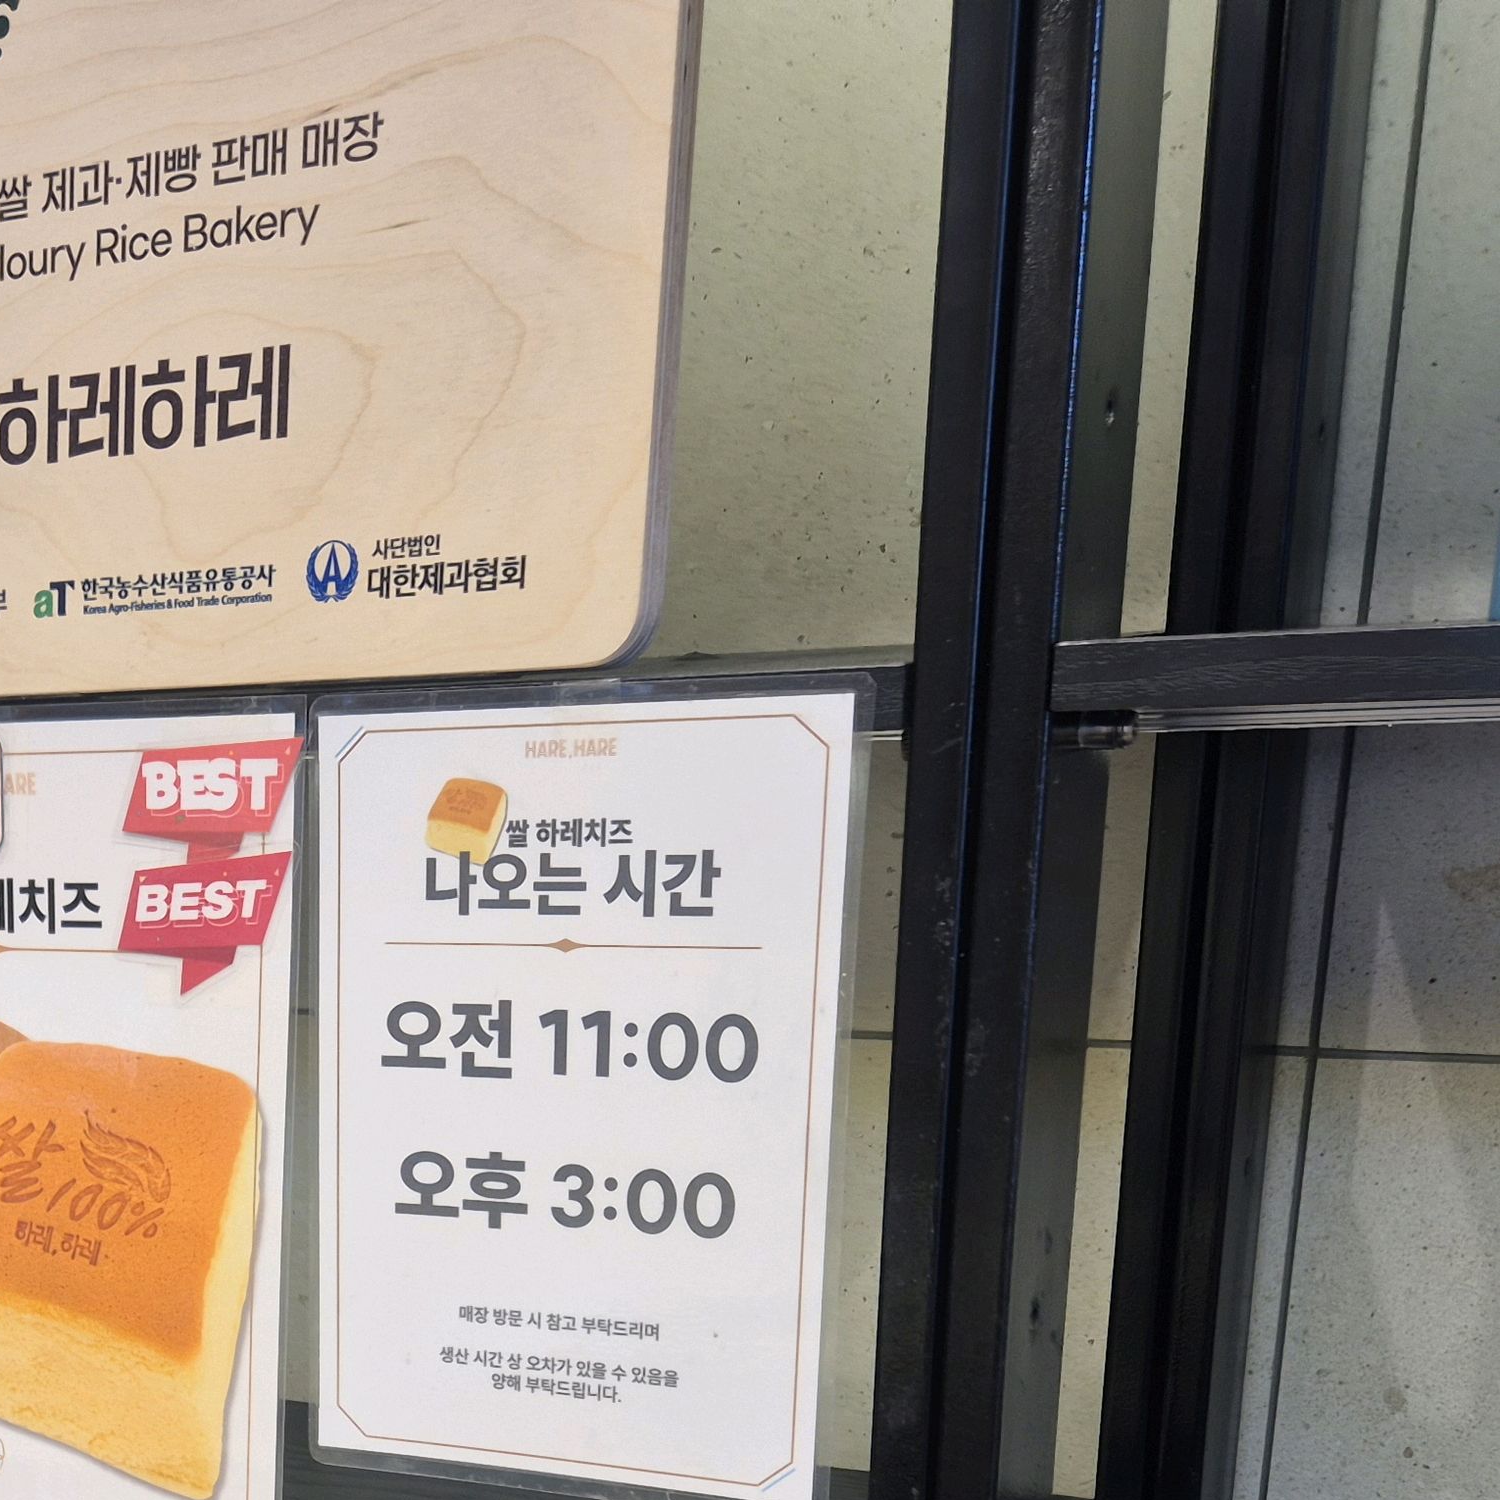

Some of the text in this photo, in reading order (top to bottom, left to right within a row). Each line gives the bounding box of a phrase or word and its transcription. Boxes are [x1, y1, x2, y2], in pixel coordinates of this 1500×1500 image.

[41, 146, 200, 214] 제과·제빵
[211, 127, 288, 186] 판매
[302, 111, 384, 171] 매장
[95, 226, 172, 268] Rice
[184, 201, 320, 254] Bakery
[371, 533, 441, 560] 사단법인
[33, 580, 76, 618] aT
[81, 564, 277, 601] 한국농수산식품유통공사
[367, 555, 526, 600] 대한제과협회
[83, 592, 273, 615] Korea Agro-Fisheries & Food Trade Corporation
[141, 757, 282, 814] BEST
[506, 817, 634, 848] 쌀 하레치즈
[134, 879, 270, 924] BEST
[424, 849, 722, 918] 나오는 시간
[380, 999, 760, 1084] 오전 11:00
[45, 1176, 165, 1240] 100%
[394, 1149, 736, 1239] 오후 3:00
[458, 1305, 660, 1342] 매장 방문 시 참고 부탁드리며
[439, 1345, 679, 1388] 생산 시간 상 오차가 있을 수 있음을
[491, 1373, 622, 1404] 양해 부탁드립니다.
